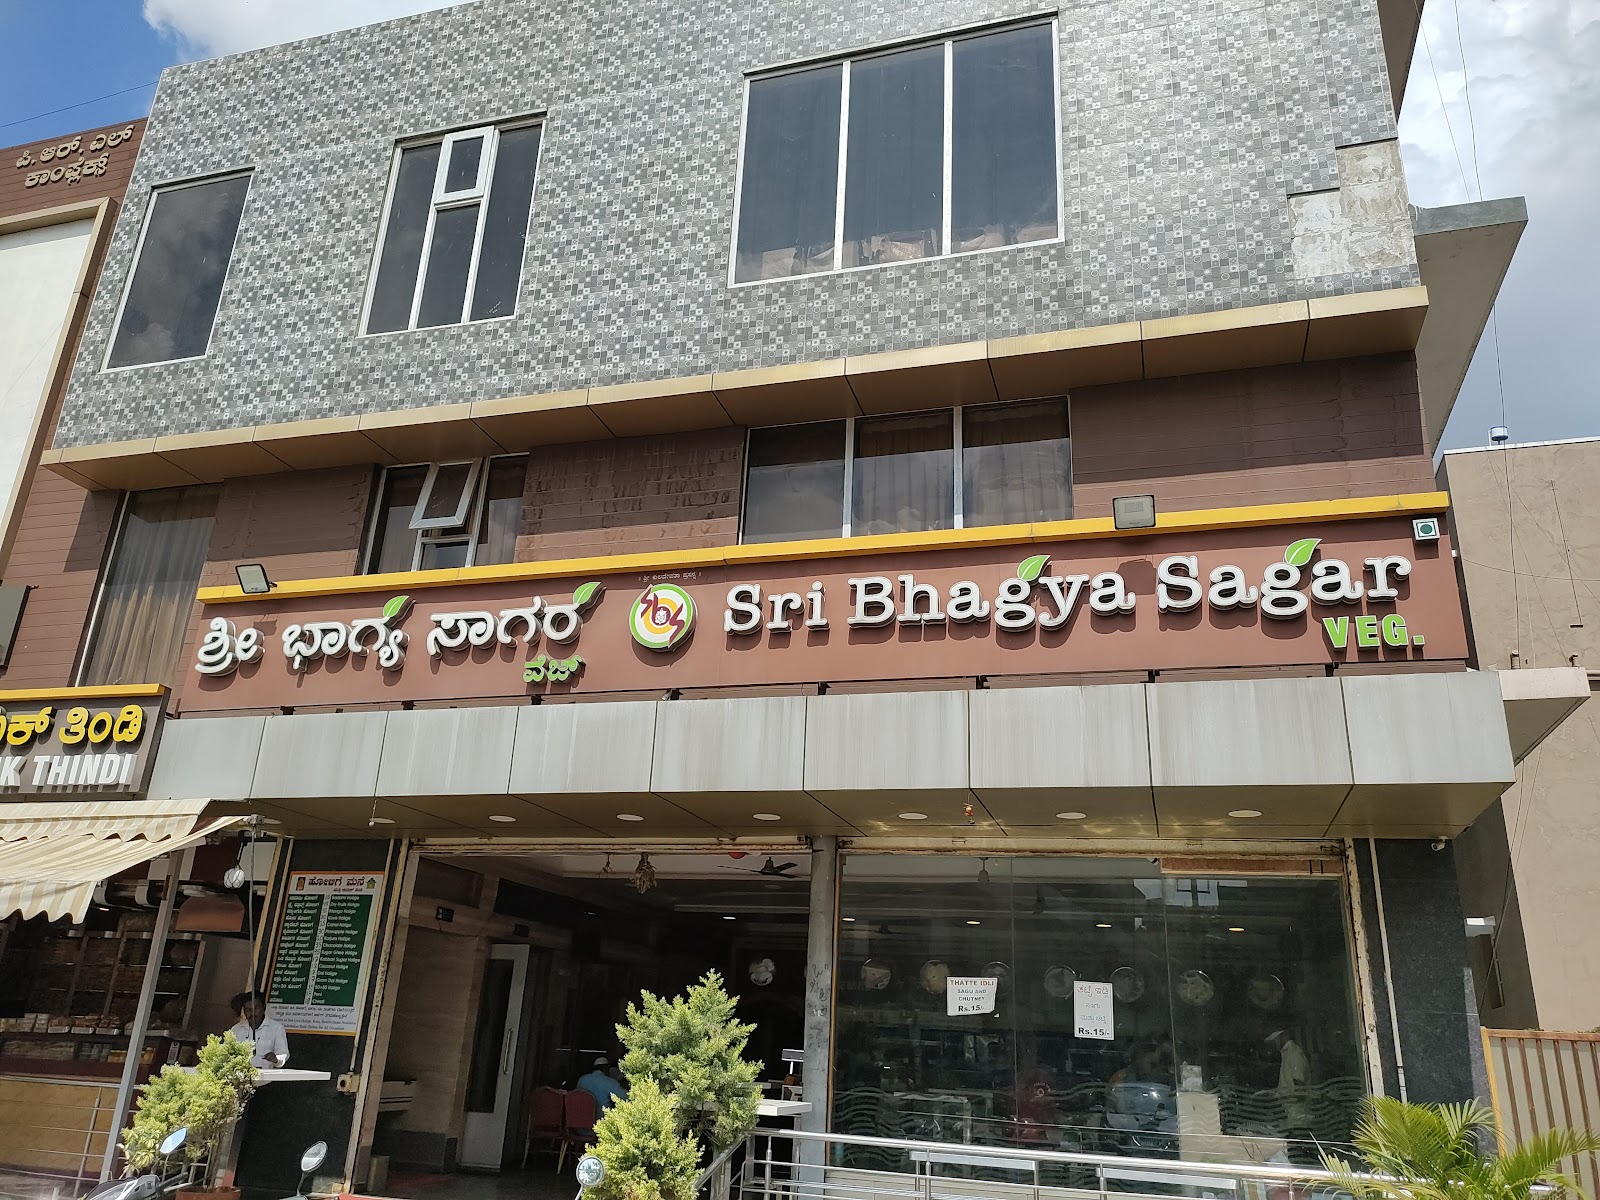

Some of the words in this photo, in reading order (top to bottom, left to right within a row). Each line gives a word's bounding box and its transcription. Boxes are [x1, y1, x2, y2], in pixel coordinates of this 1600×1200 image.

[723, 581, 830, 635] Sri
[847, 568, 1138, 634] Bhagya
[1157, 552, 1412, 620] Sagar
[195, 616, 265, 677] ಶ್ರೀ
[282, 597, 411, 672] ಭಾಗ್ಯ
[59, 704, 144, 745] ತಿಂಡಿ
[32, 752, 137, 787] THINDI
[1078, 1027, 1110, 1036] Rs.15/-
